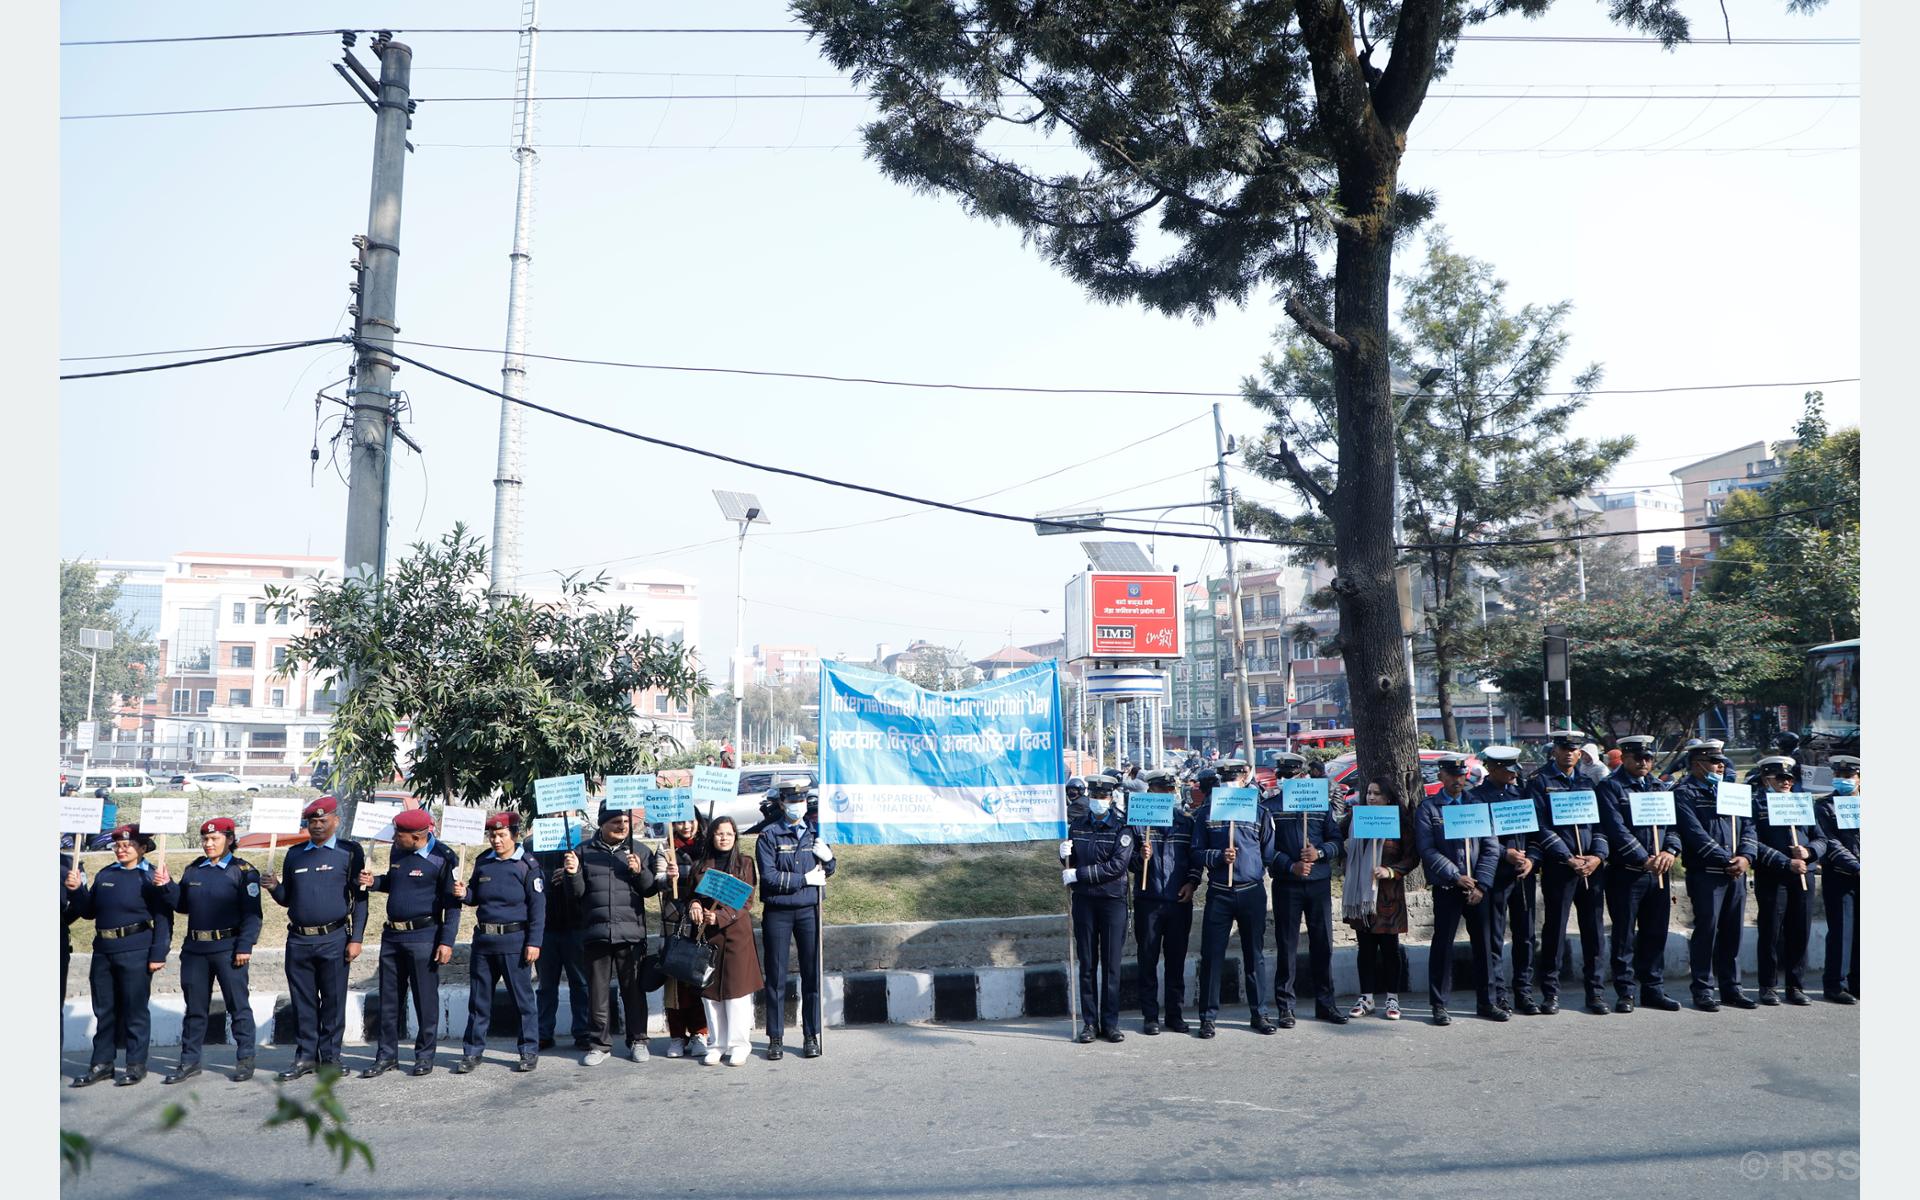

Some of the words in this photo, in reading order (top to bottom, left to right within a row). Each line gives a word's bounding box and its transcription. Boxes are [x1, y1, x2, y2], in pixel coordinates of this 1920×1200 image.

[1103, 628, 1132, 639] IME
[831, 688, 917, 717] International
[919, 690, 1024, 721] Anti-Corruption
[1028, 689, 1050, 719] Day
[1020, 727, 1052, 751] दिवस
[1130, 796, 1165, 804] Corruption
